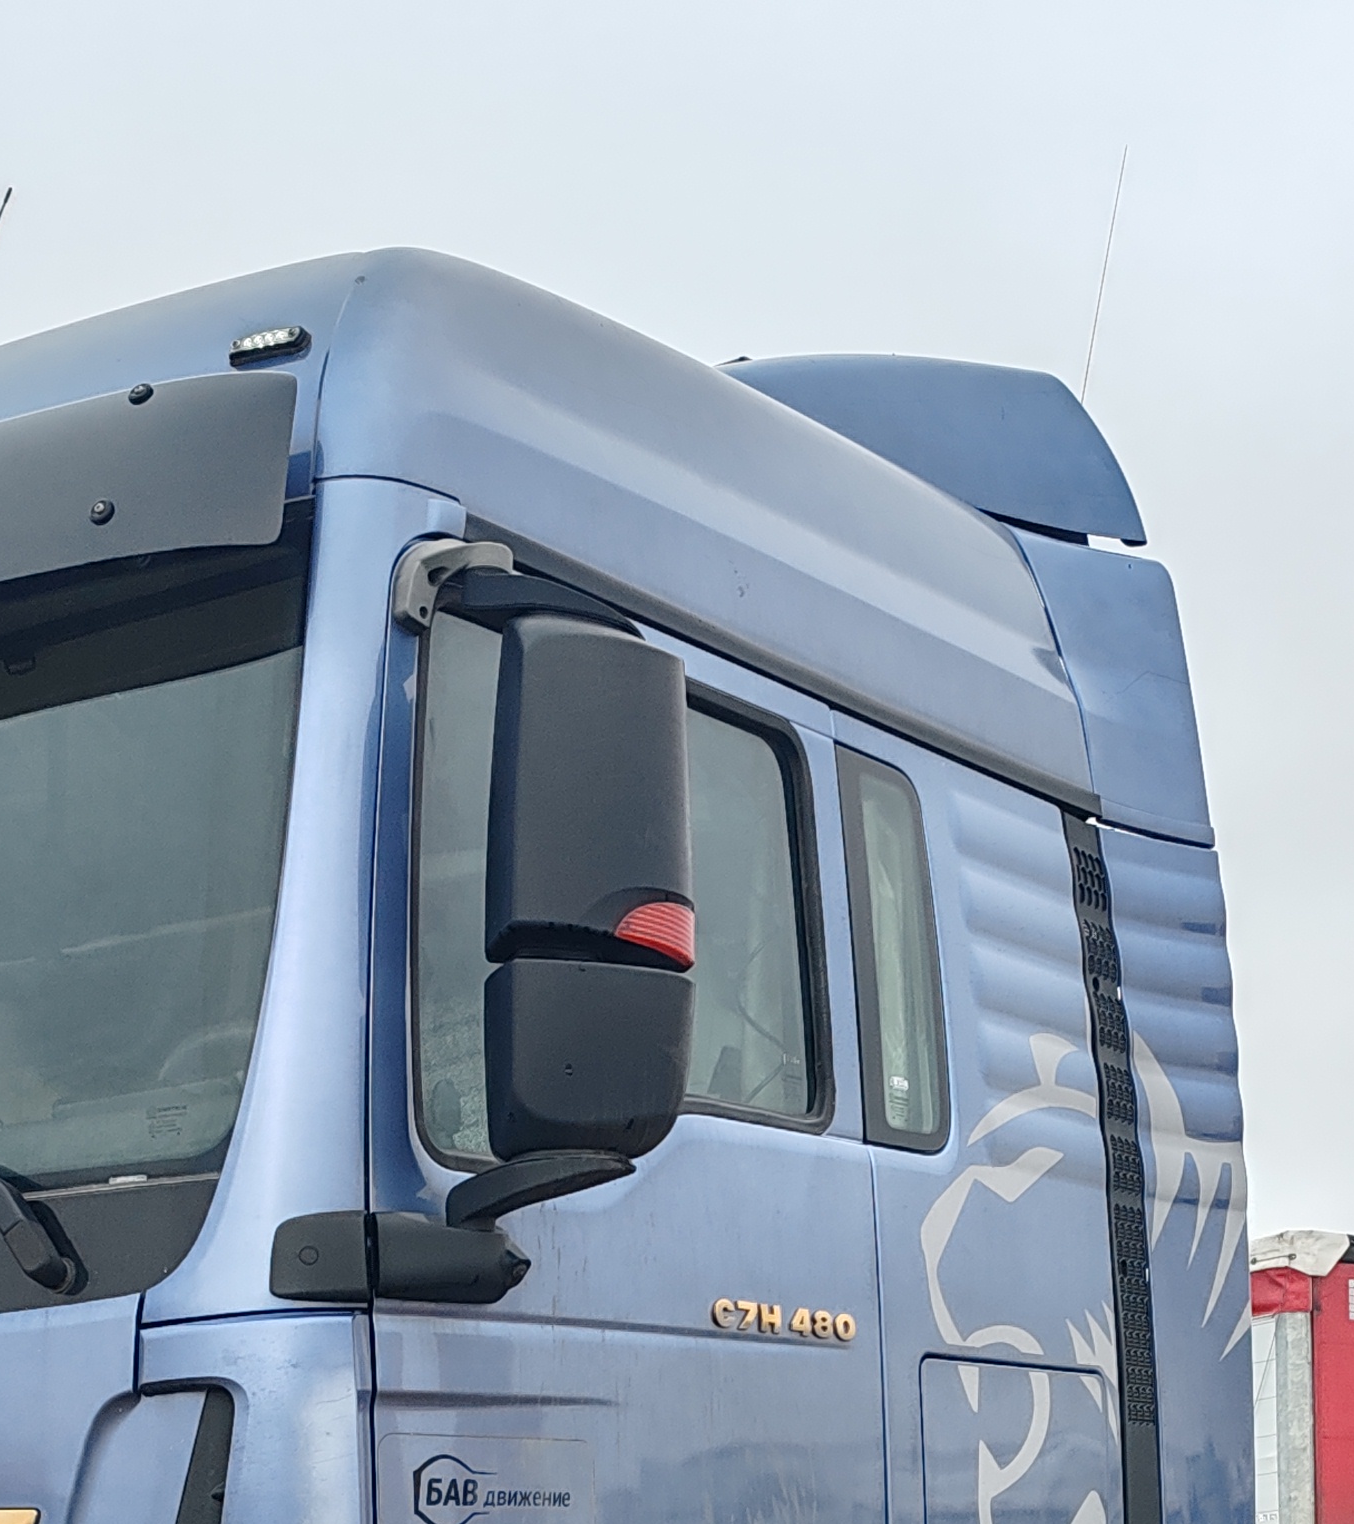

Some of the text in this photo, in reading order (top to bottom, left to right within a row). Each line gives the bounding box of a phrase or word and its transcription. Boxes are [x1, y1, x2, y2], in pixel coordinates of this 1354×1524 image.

[711, 1298, 857, 1342] C7H 480
[425, 1477, 571, 1508] БАВ движение
